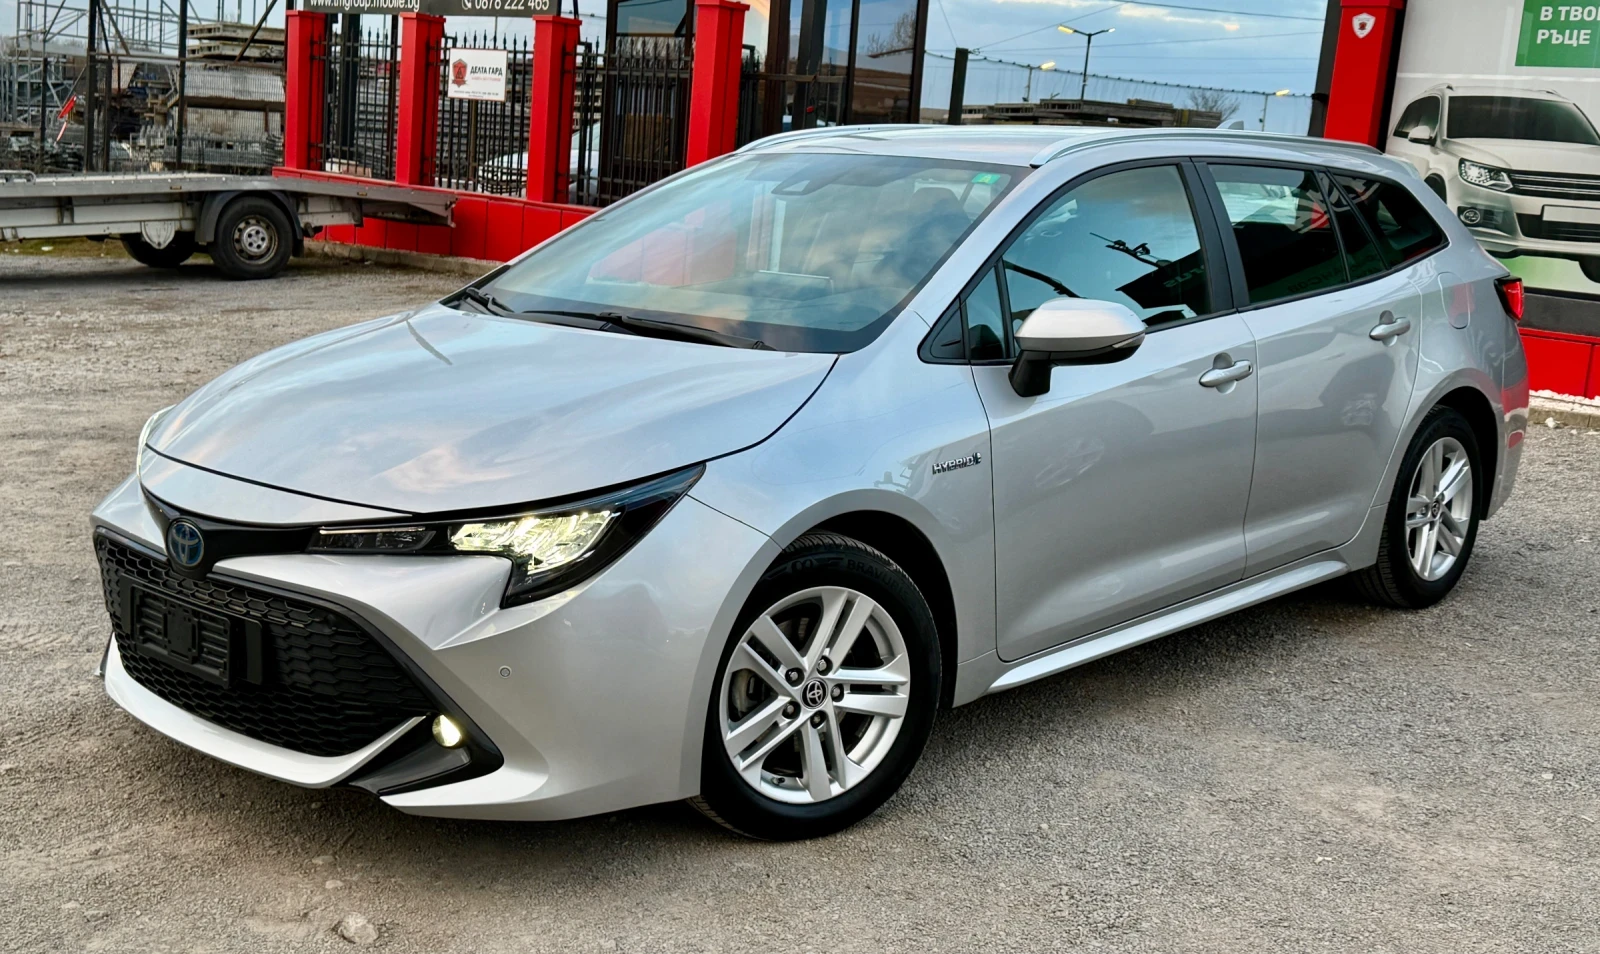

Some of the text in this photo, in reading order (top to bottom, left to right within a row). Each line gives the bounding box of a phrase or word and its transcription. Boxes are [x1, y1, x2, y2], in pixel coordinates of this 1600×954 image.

[504, 0, 525, 10] 222
[1540, 6, 1553, 21] В
[1537, 29, 1592, 47] РЪЦЕ
[470, 66, 503, 76] ДЕЛТА ГАРД
[932, 456, 974, 475] HYBRID
